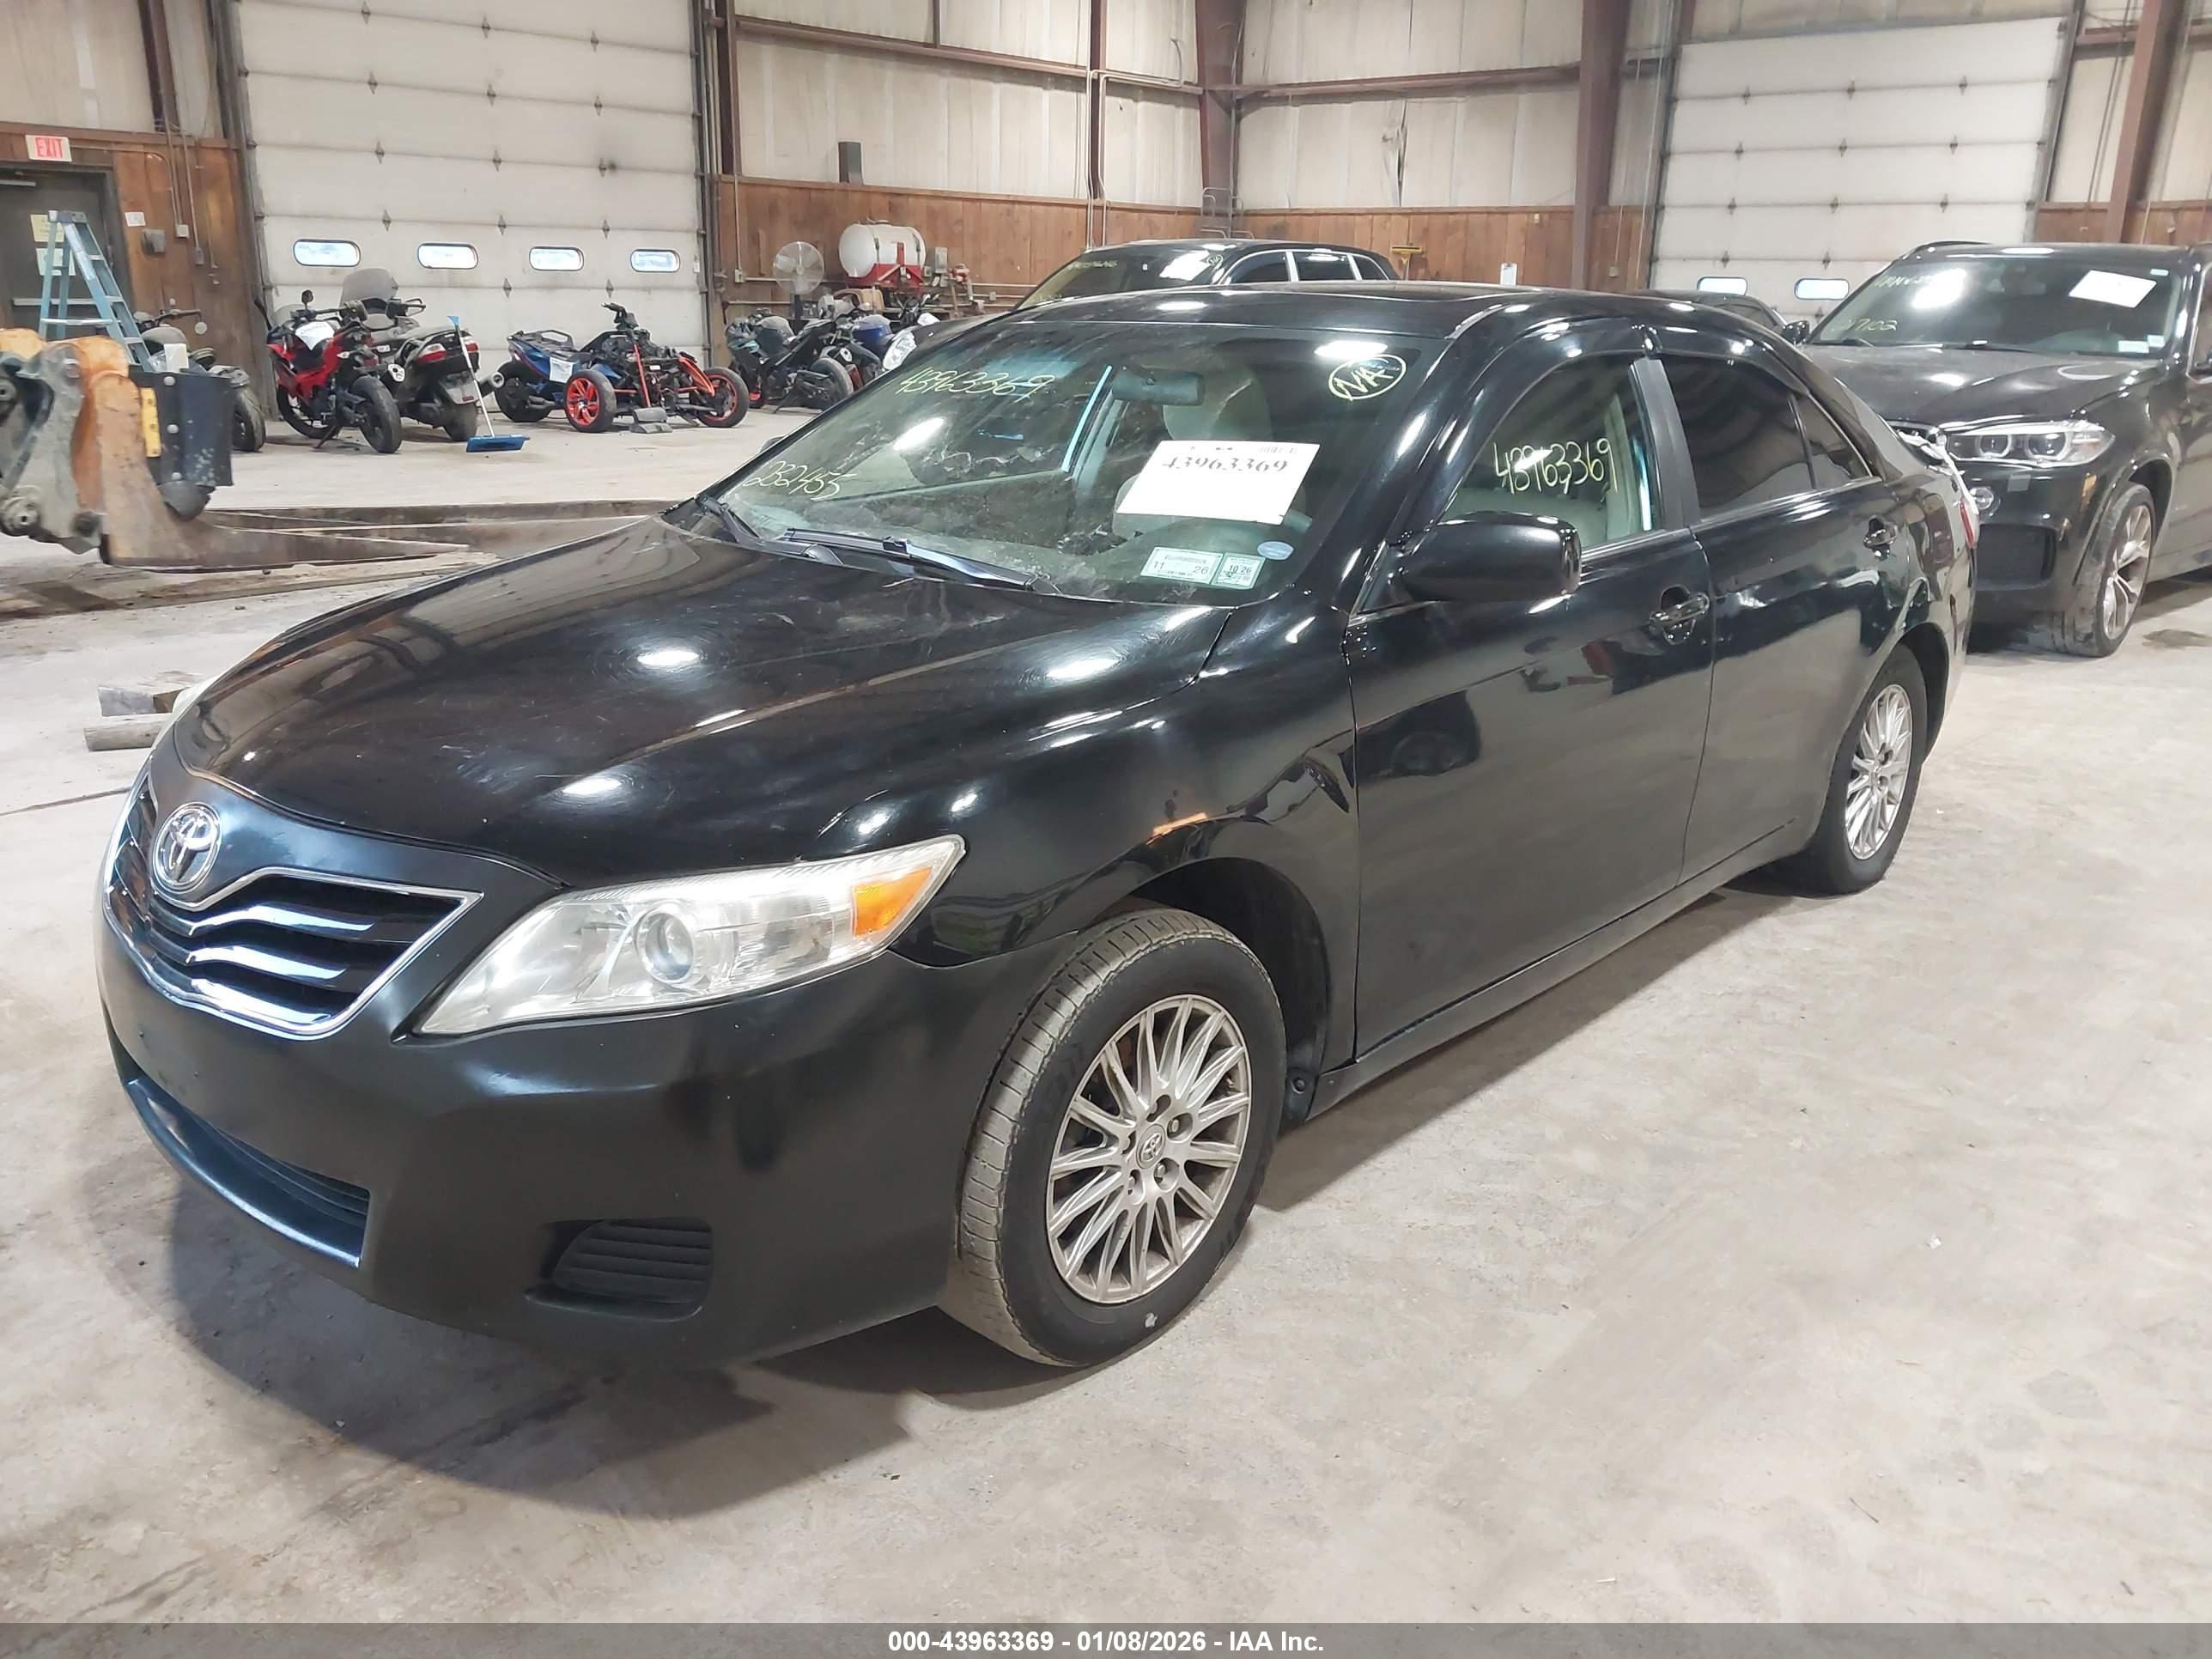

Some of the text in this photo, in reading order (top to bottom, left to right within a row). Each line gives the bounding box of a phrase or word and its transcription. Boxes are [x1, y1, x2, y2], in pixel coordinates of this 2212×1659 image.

[34, 137, 64, 159] EXIT
[895, 366, 1055, 403] 43963369
[1163, 456, 1288, 471] 43963369
[742, 460, 858, 501] 232455
